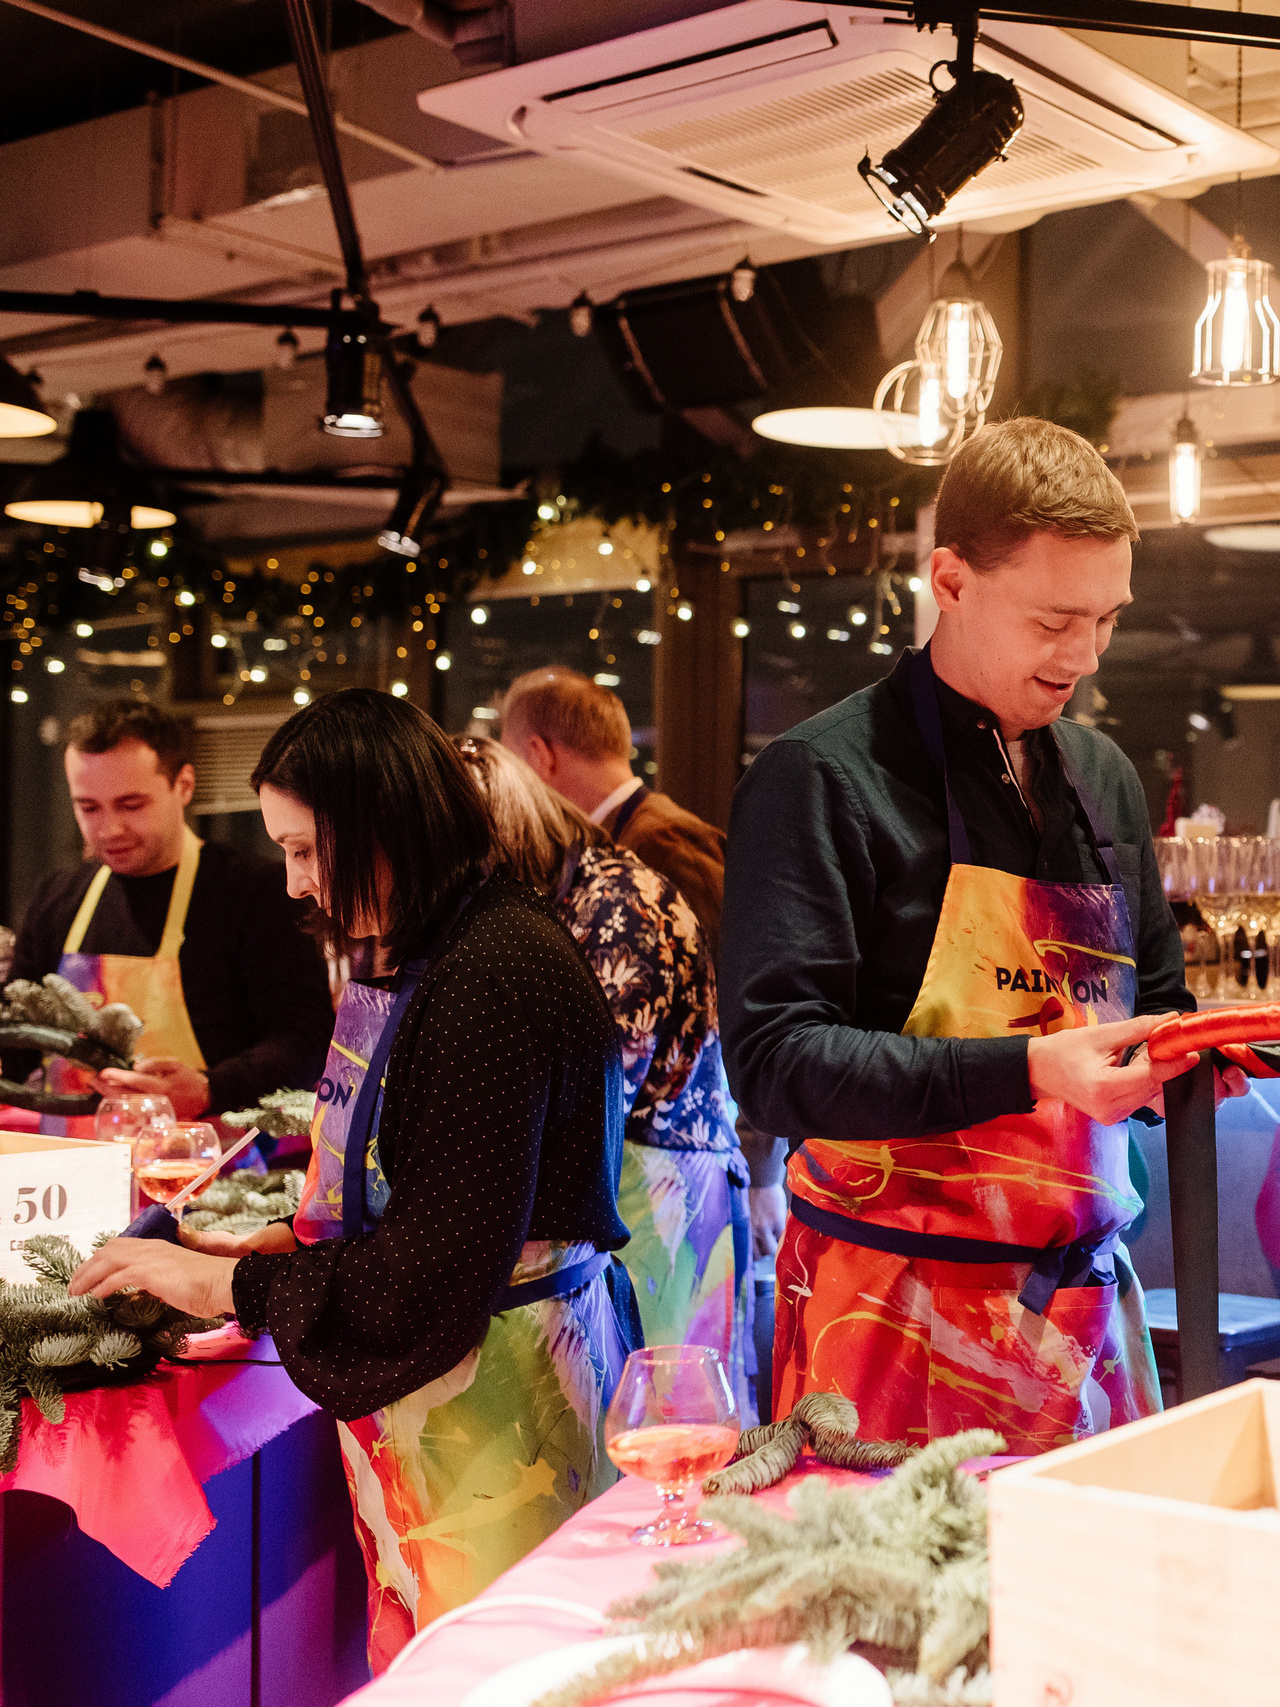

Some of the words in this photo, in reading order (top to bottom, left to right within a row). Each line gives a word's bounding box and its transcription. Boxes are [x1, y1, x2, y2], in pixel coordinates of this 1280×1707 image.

[1072, 980, 1108, 1003] ON
[318, 1077, 354, 1109] ON
[13, 1184, 67, 1224] 50
